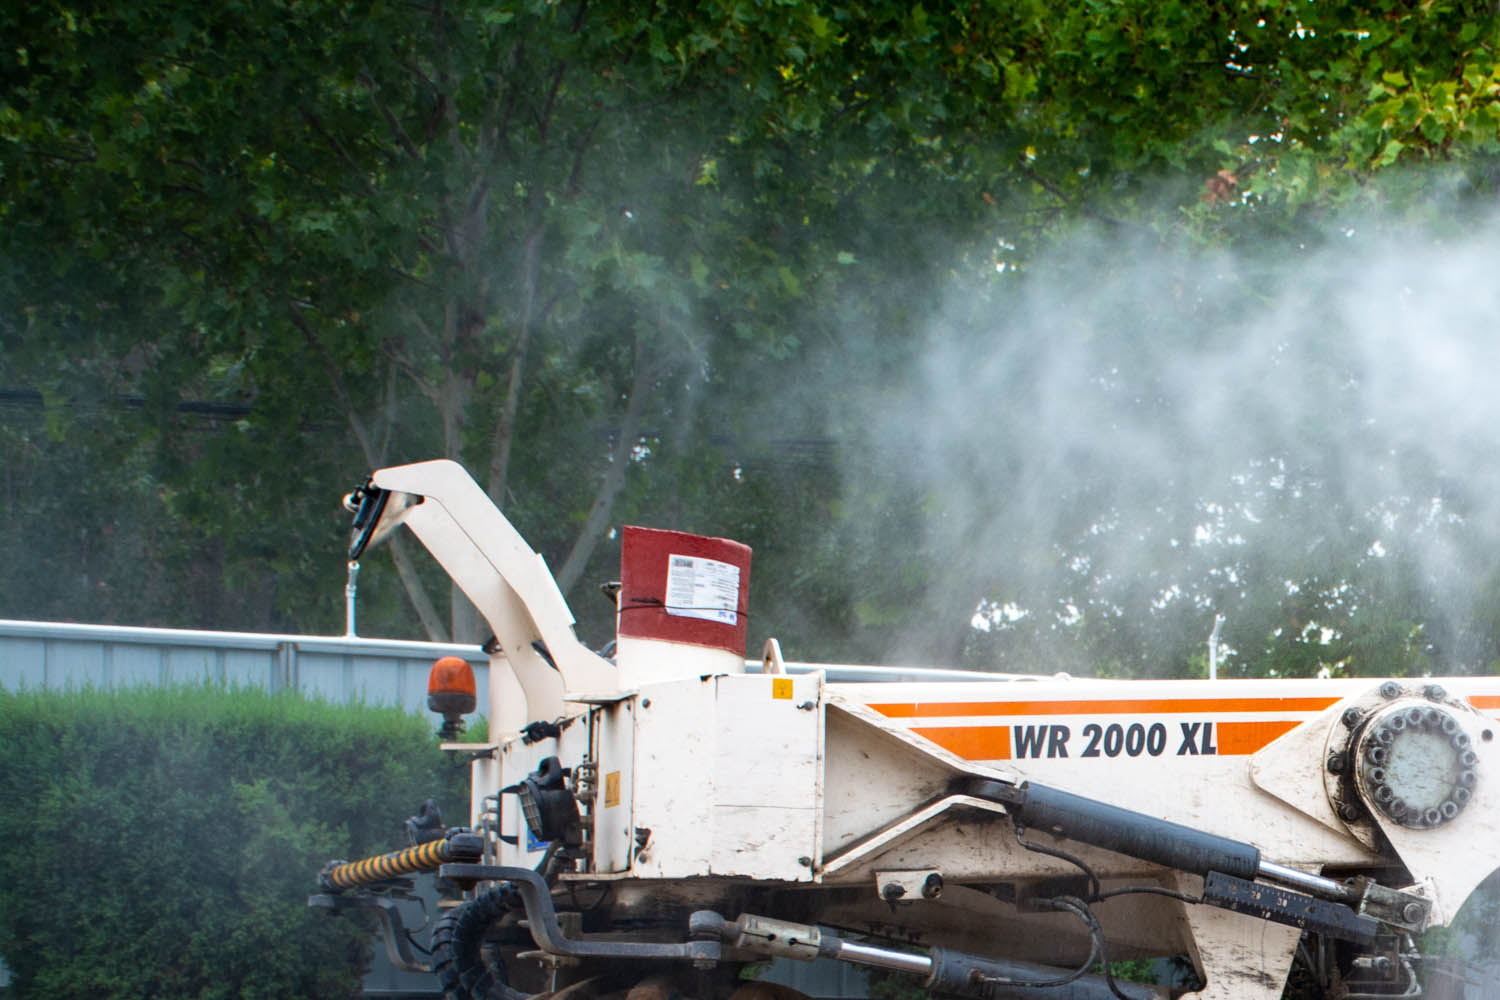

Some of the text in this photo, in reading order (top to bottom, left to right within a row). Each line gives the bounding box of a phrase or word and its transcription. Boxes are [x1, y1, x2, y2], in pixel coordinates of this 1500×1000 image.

[1014, 722, 1217, 759] WR 2000 XL
